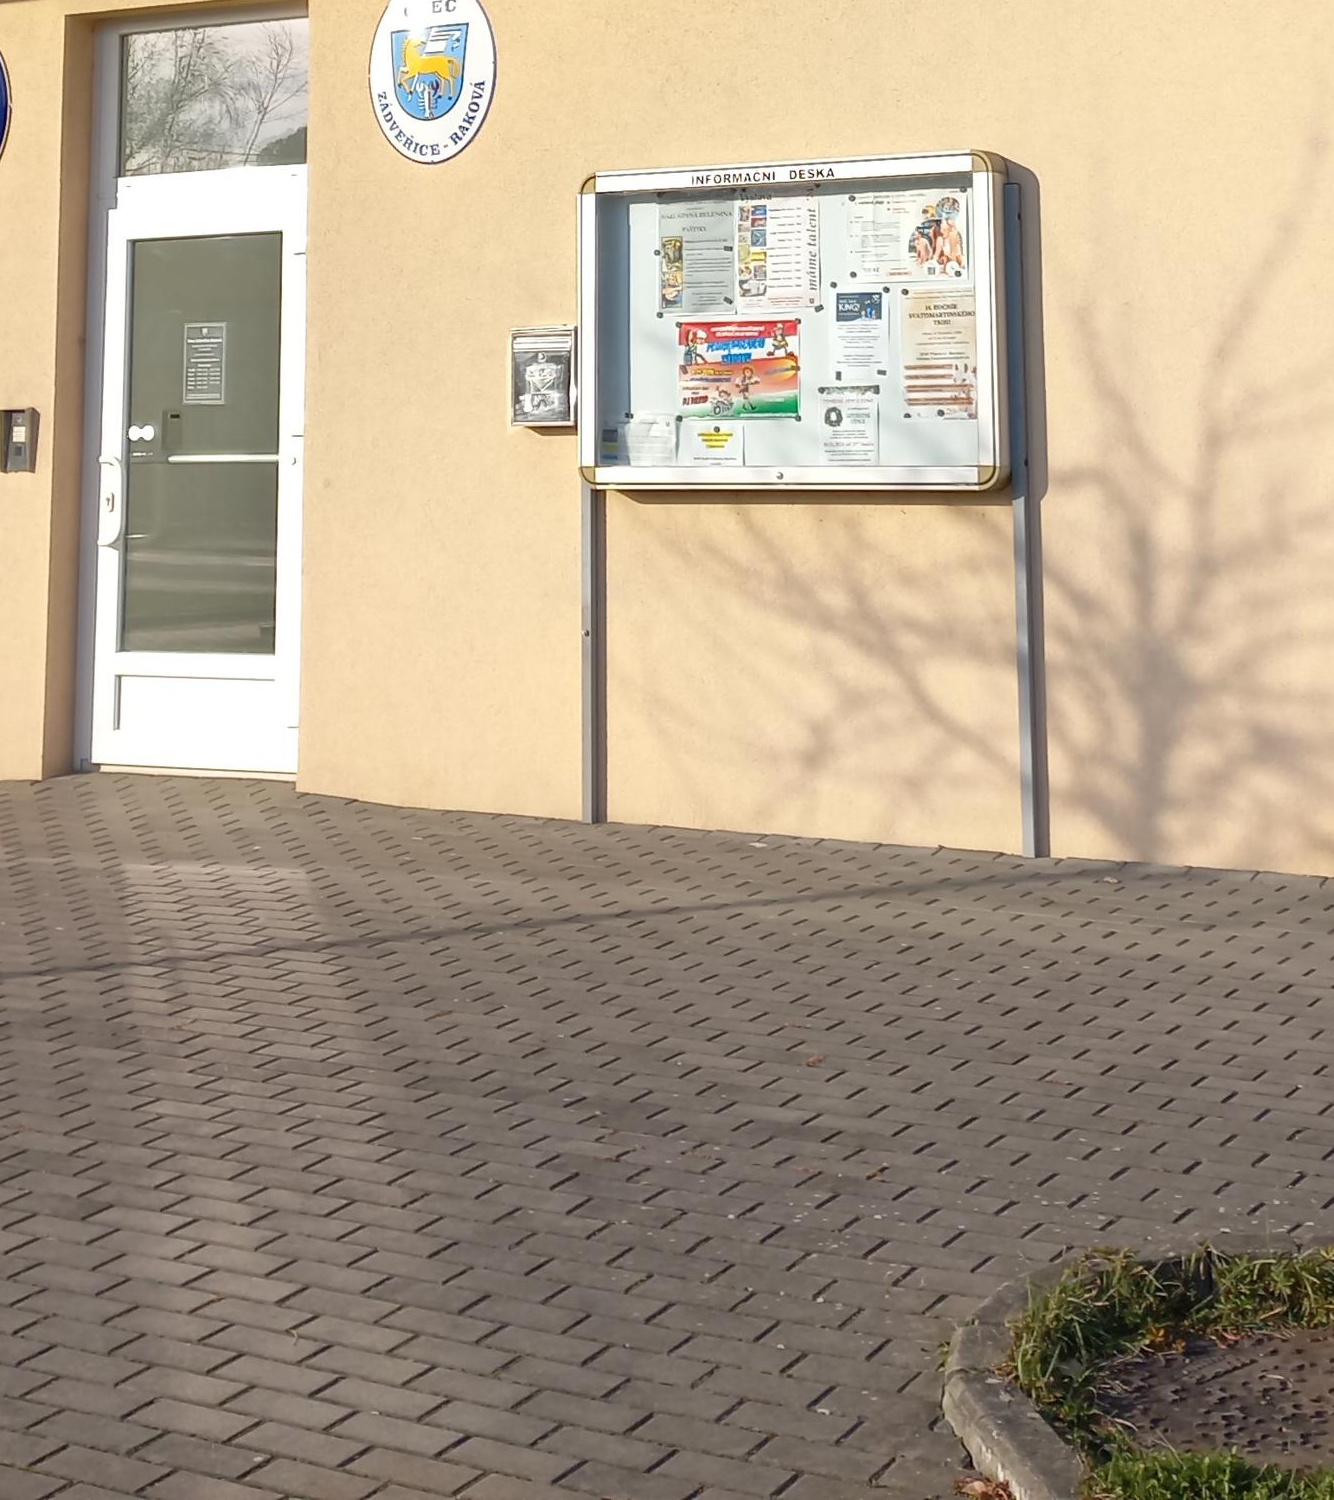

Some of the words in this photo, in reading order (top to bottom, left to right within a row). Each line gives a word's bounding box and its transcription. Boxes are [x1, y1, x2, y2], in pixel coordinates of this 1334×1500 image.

[378, 91, 440, 157] ZÁDVEŘICE
[450, 79, 486, 146] RAKOVÁ
[789, 168, 835, 180] DESKA
[806, 208, 818, 247] talent
